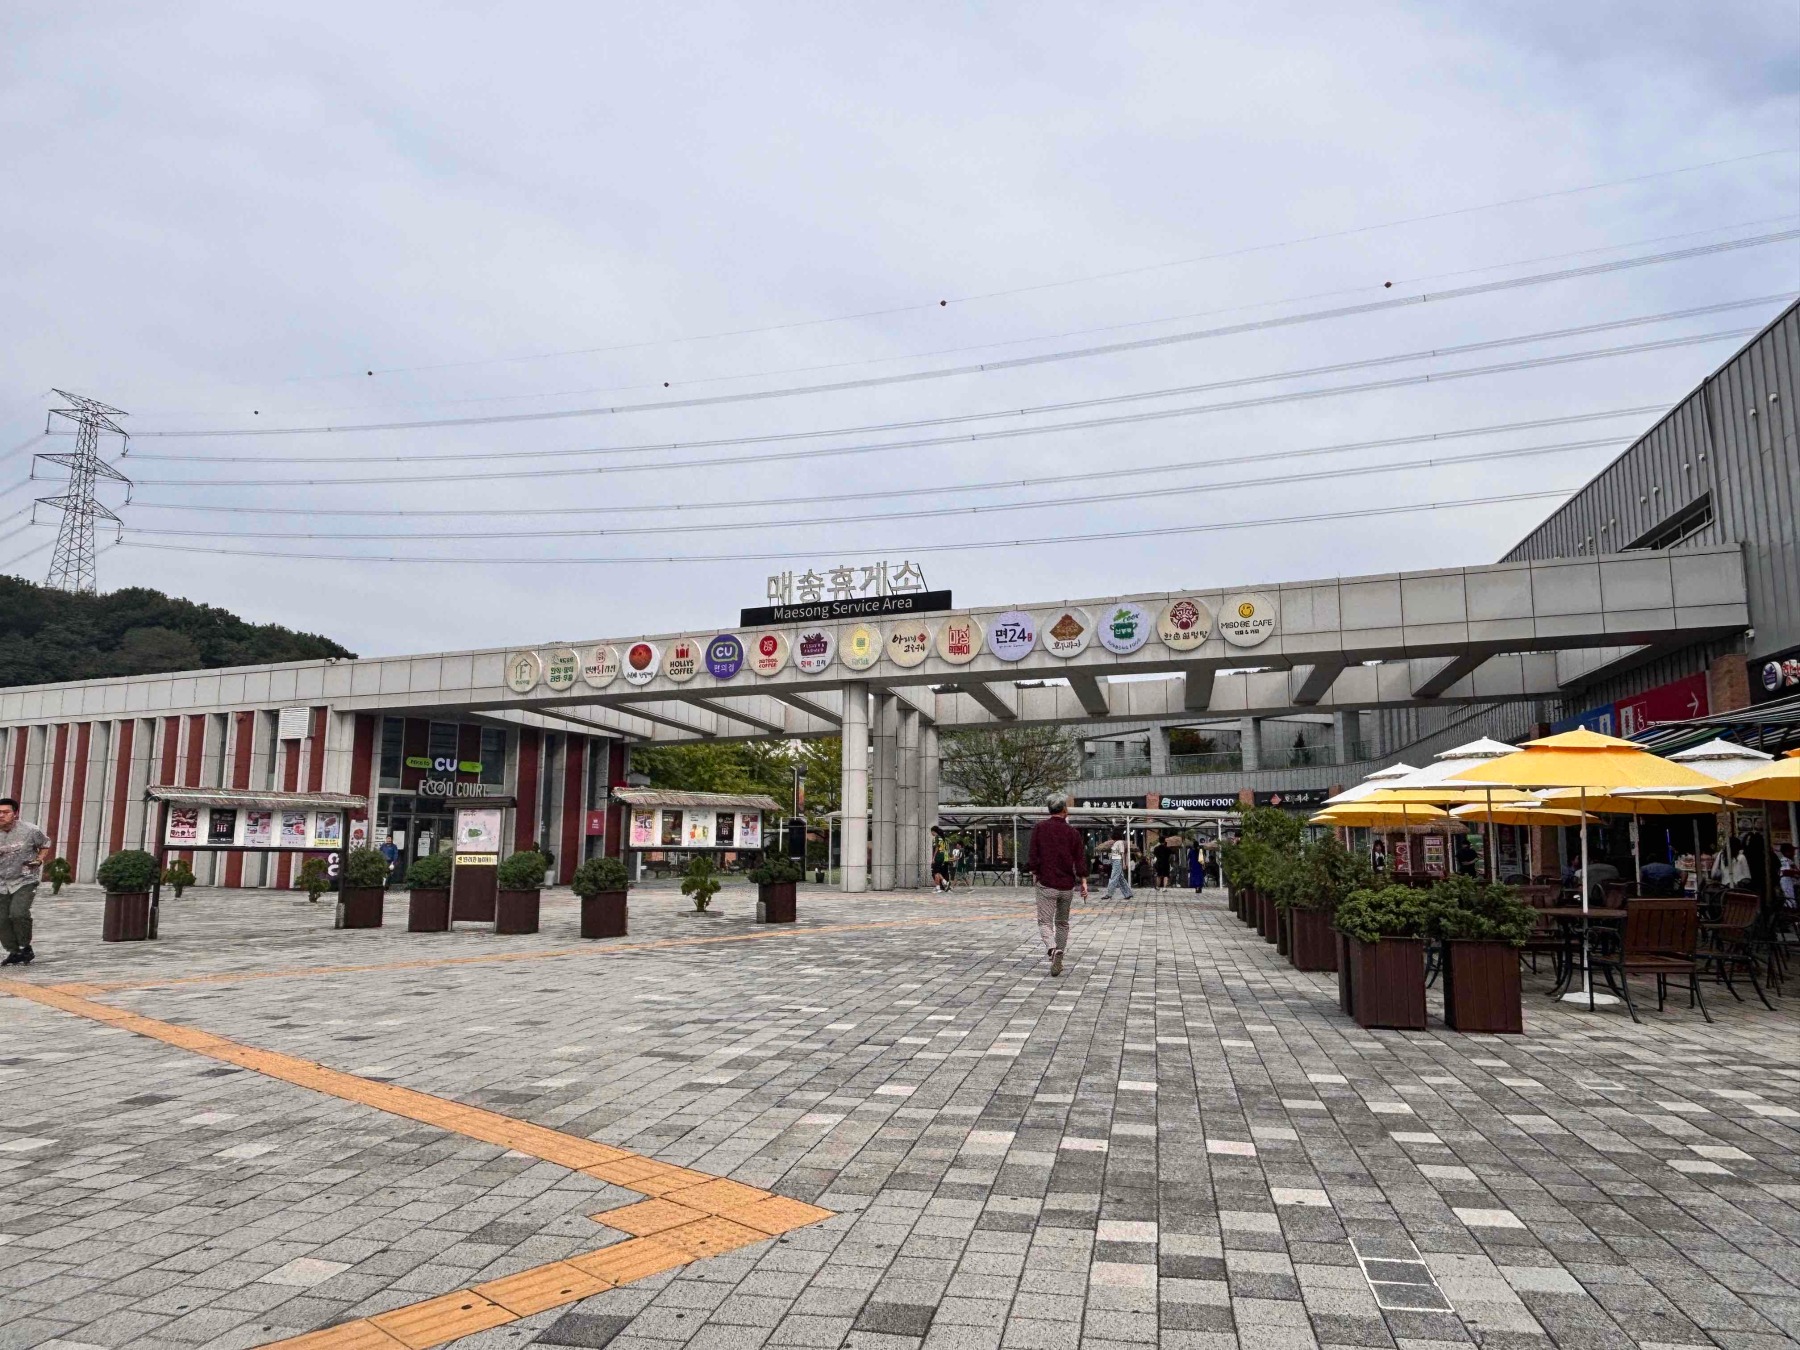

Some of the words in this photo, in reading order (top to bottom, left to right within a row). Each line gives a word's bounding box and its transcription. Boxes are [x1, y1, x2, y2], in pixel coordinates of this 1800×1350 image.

[767, 561, 922, 604] 매송휴게소
[774, 606, 829, 620] Maesong
[832, 600, 880, 615] Service
[882, 597, 913, 611] Area
[1252, 619, 1273, 627] CAFE
[996, 627, 1027, 644] 면24
[716, 646, 733, 657] CU
[669, 659, 694, 668] HOLLYS
[714, 663, 735, 673] 편의점
[669, 667, 694, 675] COFFEE
[434, 757, 458, 772] CU
[418, 779, 453, 797] FOOD
[456, 782, 486, 798] COURT
[1171, 798, 1210, 807] SUNBONG
[1211, 798, 1234, 807] FOOD
